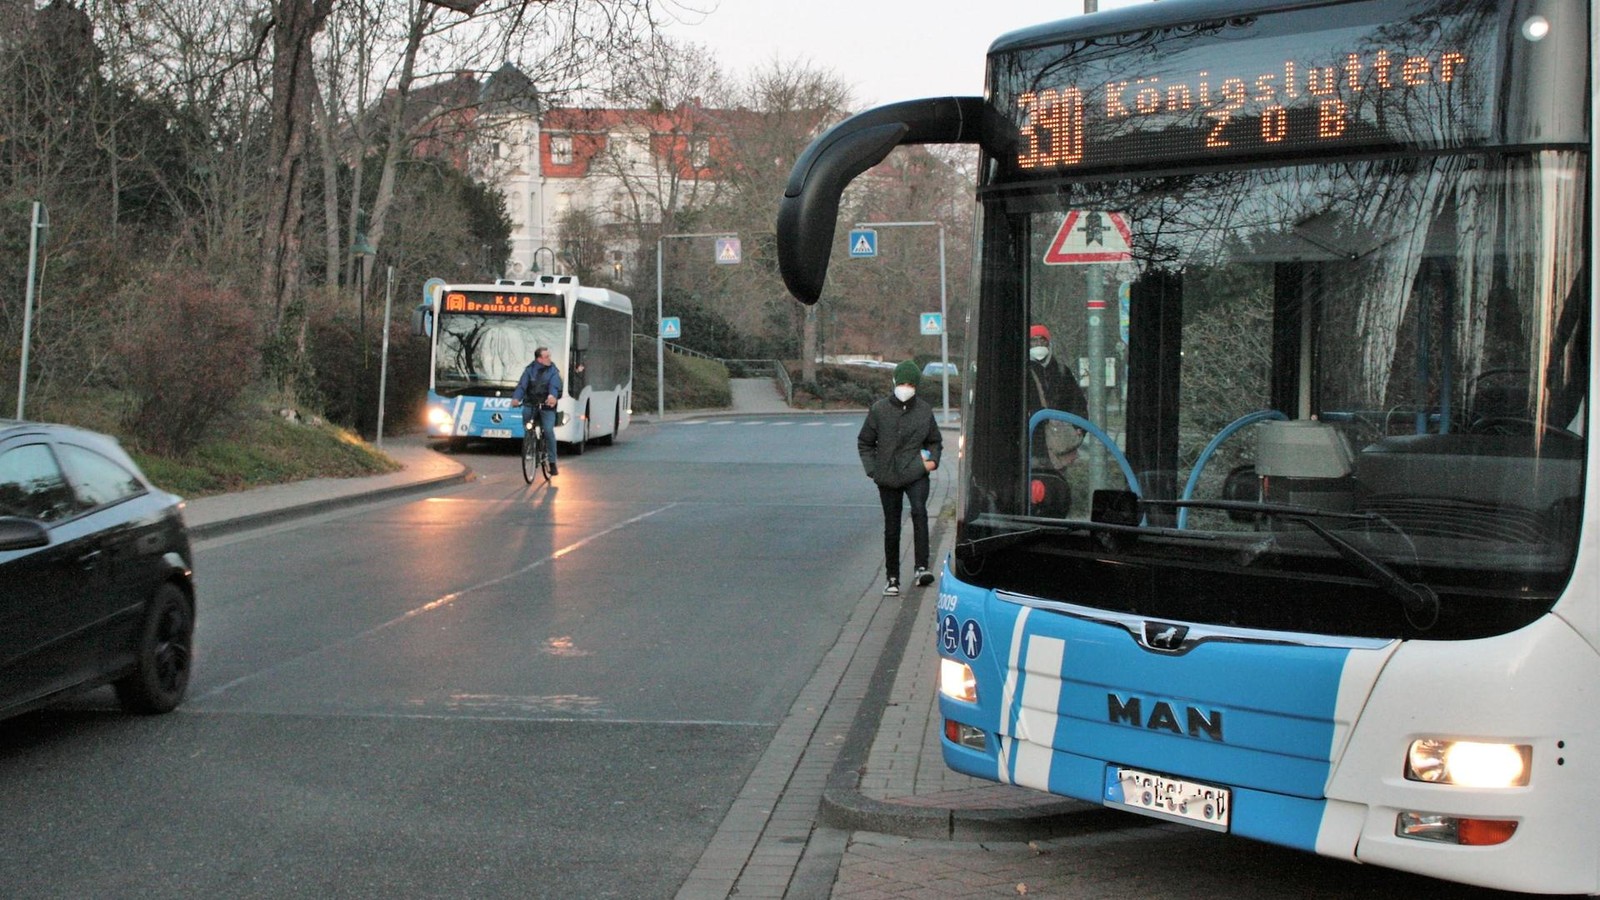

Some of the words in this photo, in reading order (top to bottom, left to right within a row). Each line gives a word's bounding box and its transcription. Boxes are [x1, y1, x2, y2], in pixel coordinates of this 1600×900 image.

[1017, 86, 1084, 169] 390
[1106, 49, 1465, 118] Königslutter
[467, 301, 558, 315] Braunschweig
[1107, 693, 1224, 742] MAN
